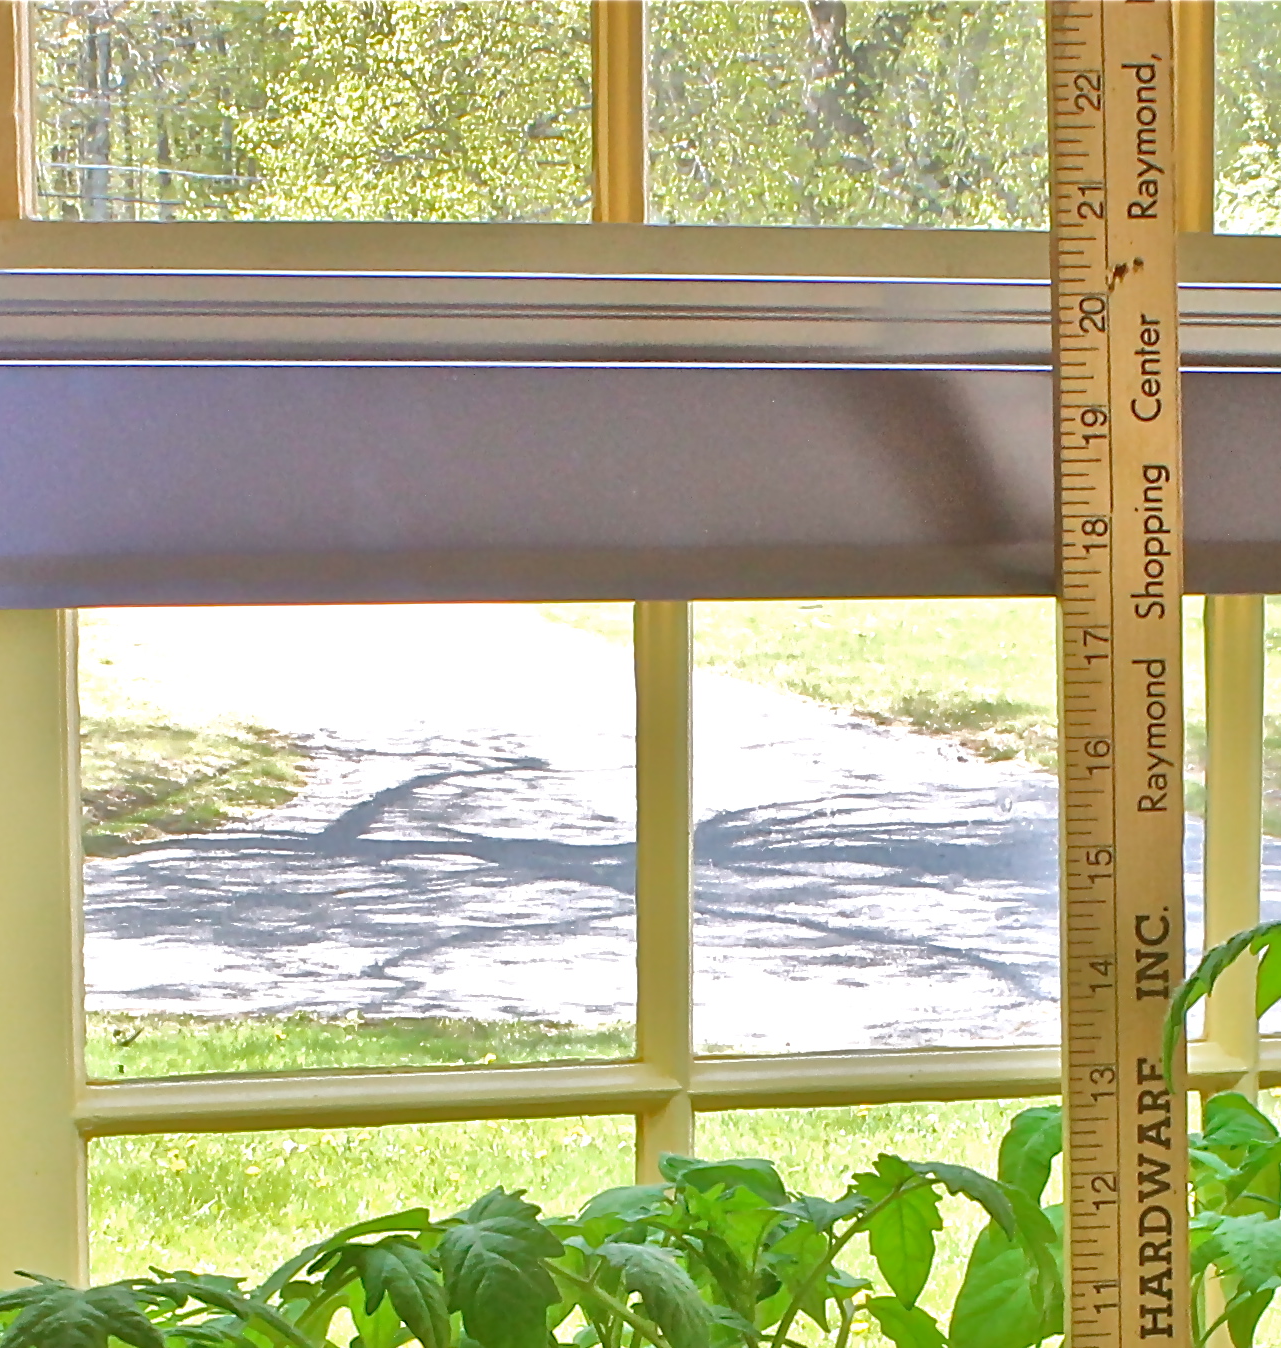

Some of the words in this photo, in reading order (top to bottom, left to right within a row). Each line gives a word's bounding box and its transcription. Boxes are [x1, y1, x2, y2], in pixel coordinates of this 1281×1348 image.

[1074, 73, 1102, 112] 22
[1120, 52, 1164, 220] Raymond,
[1077, 184, 1104, 220] 21
[1079, 295, 1107, 334] 20
[1130, 313, 1163, 422] Center
[1081, 407, 1108, 445] 19
[1081, 517, 1109, 555] 18
[1131, 463, 1171, 620] Shopping
[1083, 628, 1110, 665] 17
[1132, 658, 1174, 813] Raymond
[1084, 739, 1112, 776] 16
[1086, 848, 1114, 883] 15
[1134, 905, 1171, 1002] INC.
[1089, 958, 1115, 993] 14
[1089, 1066, 1116, 1102] 13
[1091, 1175, 1118, 1211] 12
[1136, 1056, 1174, 1341] HARDWARE
[1093, 1279, 1119, 1314] 11
